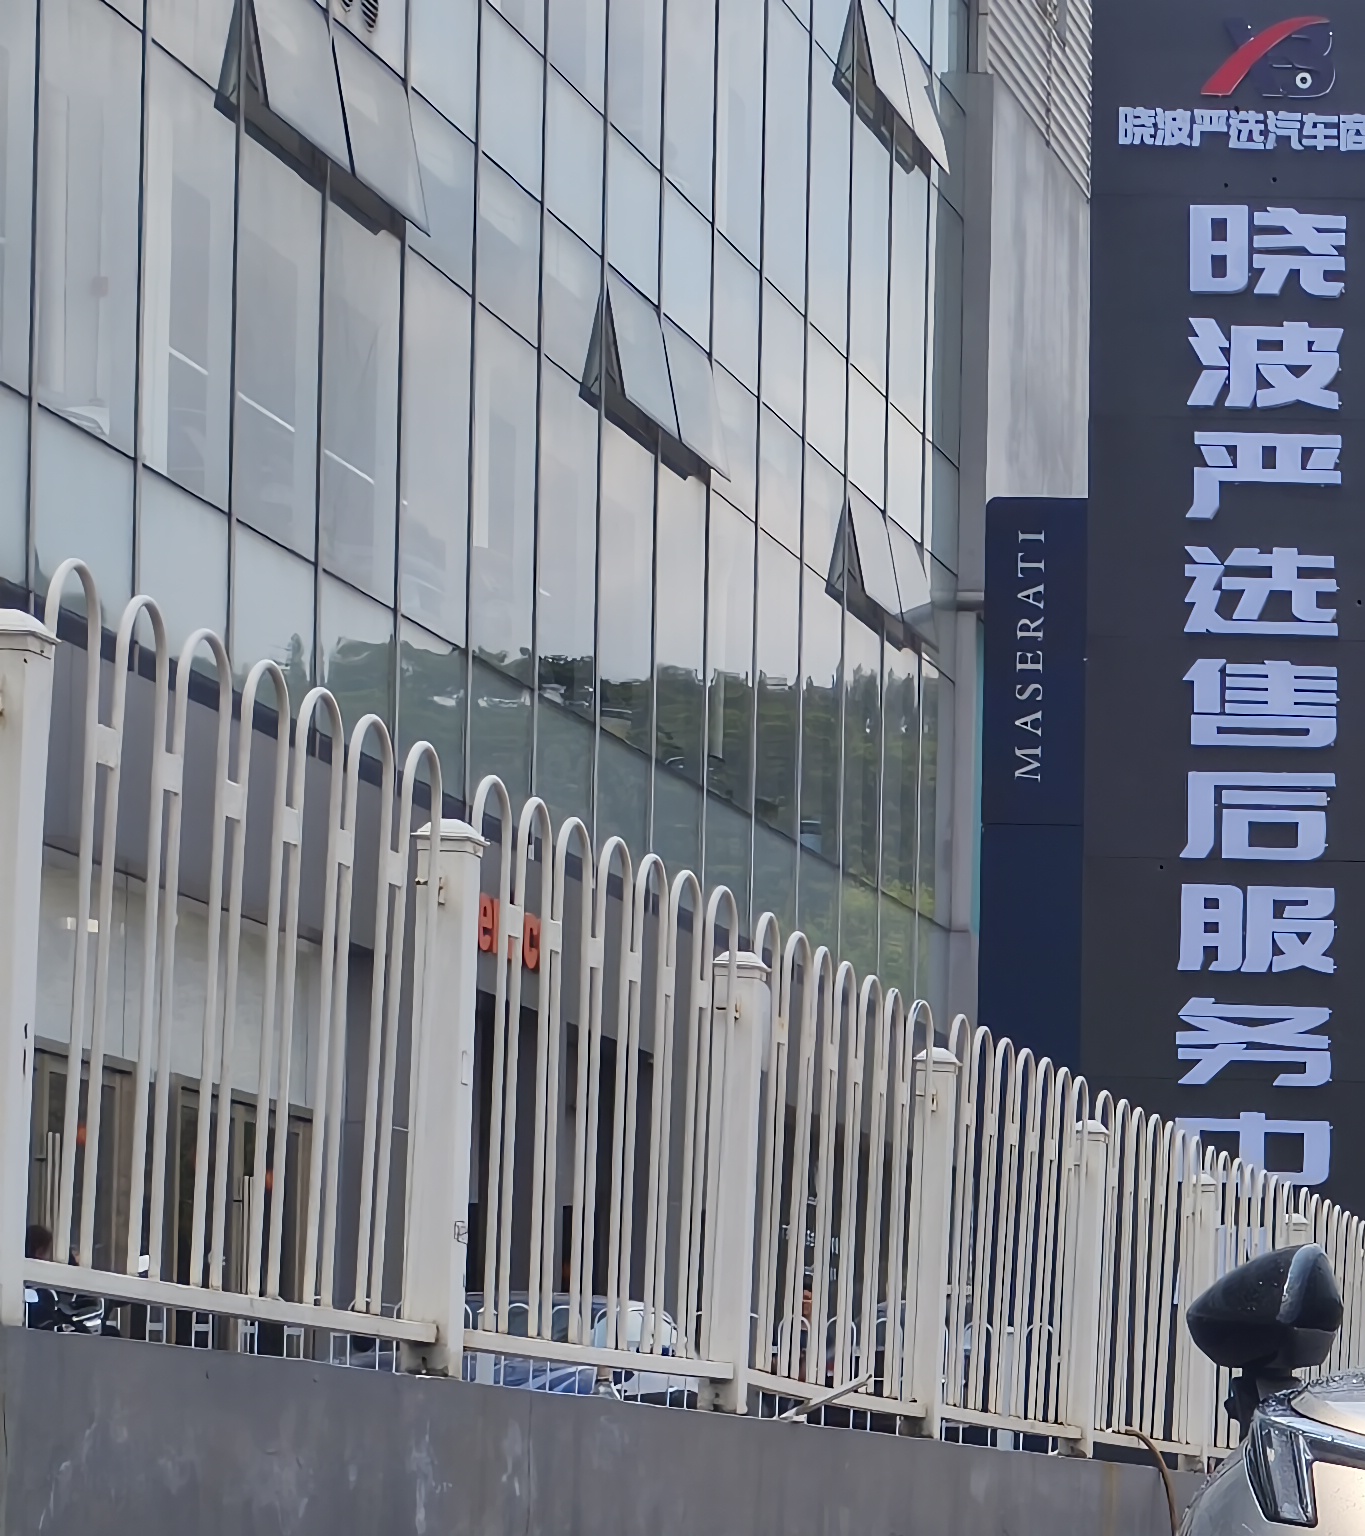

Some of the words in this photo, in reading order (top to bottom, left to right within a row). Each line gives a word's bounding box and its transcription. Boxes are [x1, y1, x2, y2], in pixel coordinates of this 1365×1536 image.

[1014, 529, 1046, 783] MASERATI
[1174, 203, 1348, 1302] 晓波严选售后服务中
